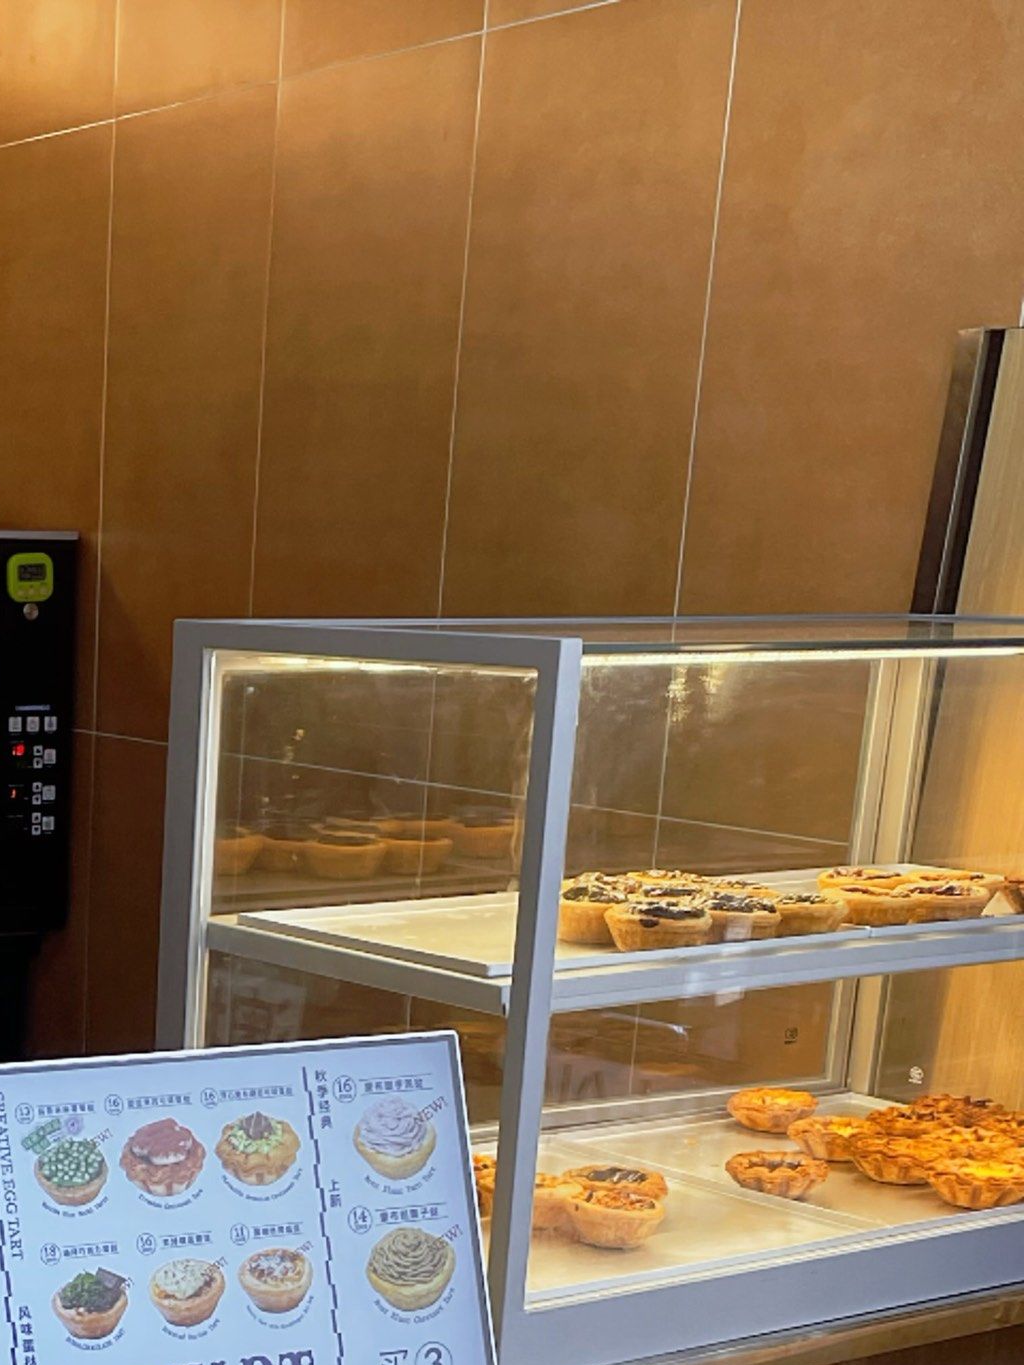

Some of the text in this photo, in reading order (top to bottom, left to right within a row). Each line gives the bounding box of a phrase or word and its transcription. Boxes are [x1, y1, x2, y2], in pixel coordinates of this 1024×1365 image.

[315, 1070, 332, 1129] 秋季经典
[336, 1079, 353, 1092] 16
[2, 1179, 17, 1215] EGG
[8, 1217, 24, 1259] TART
